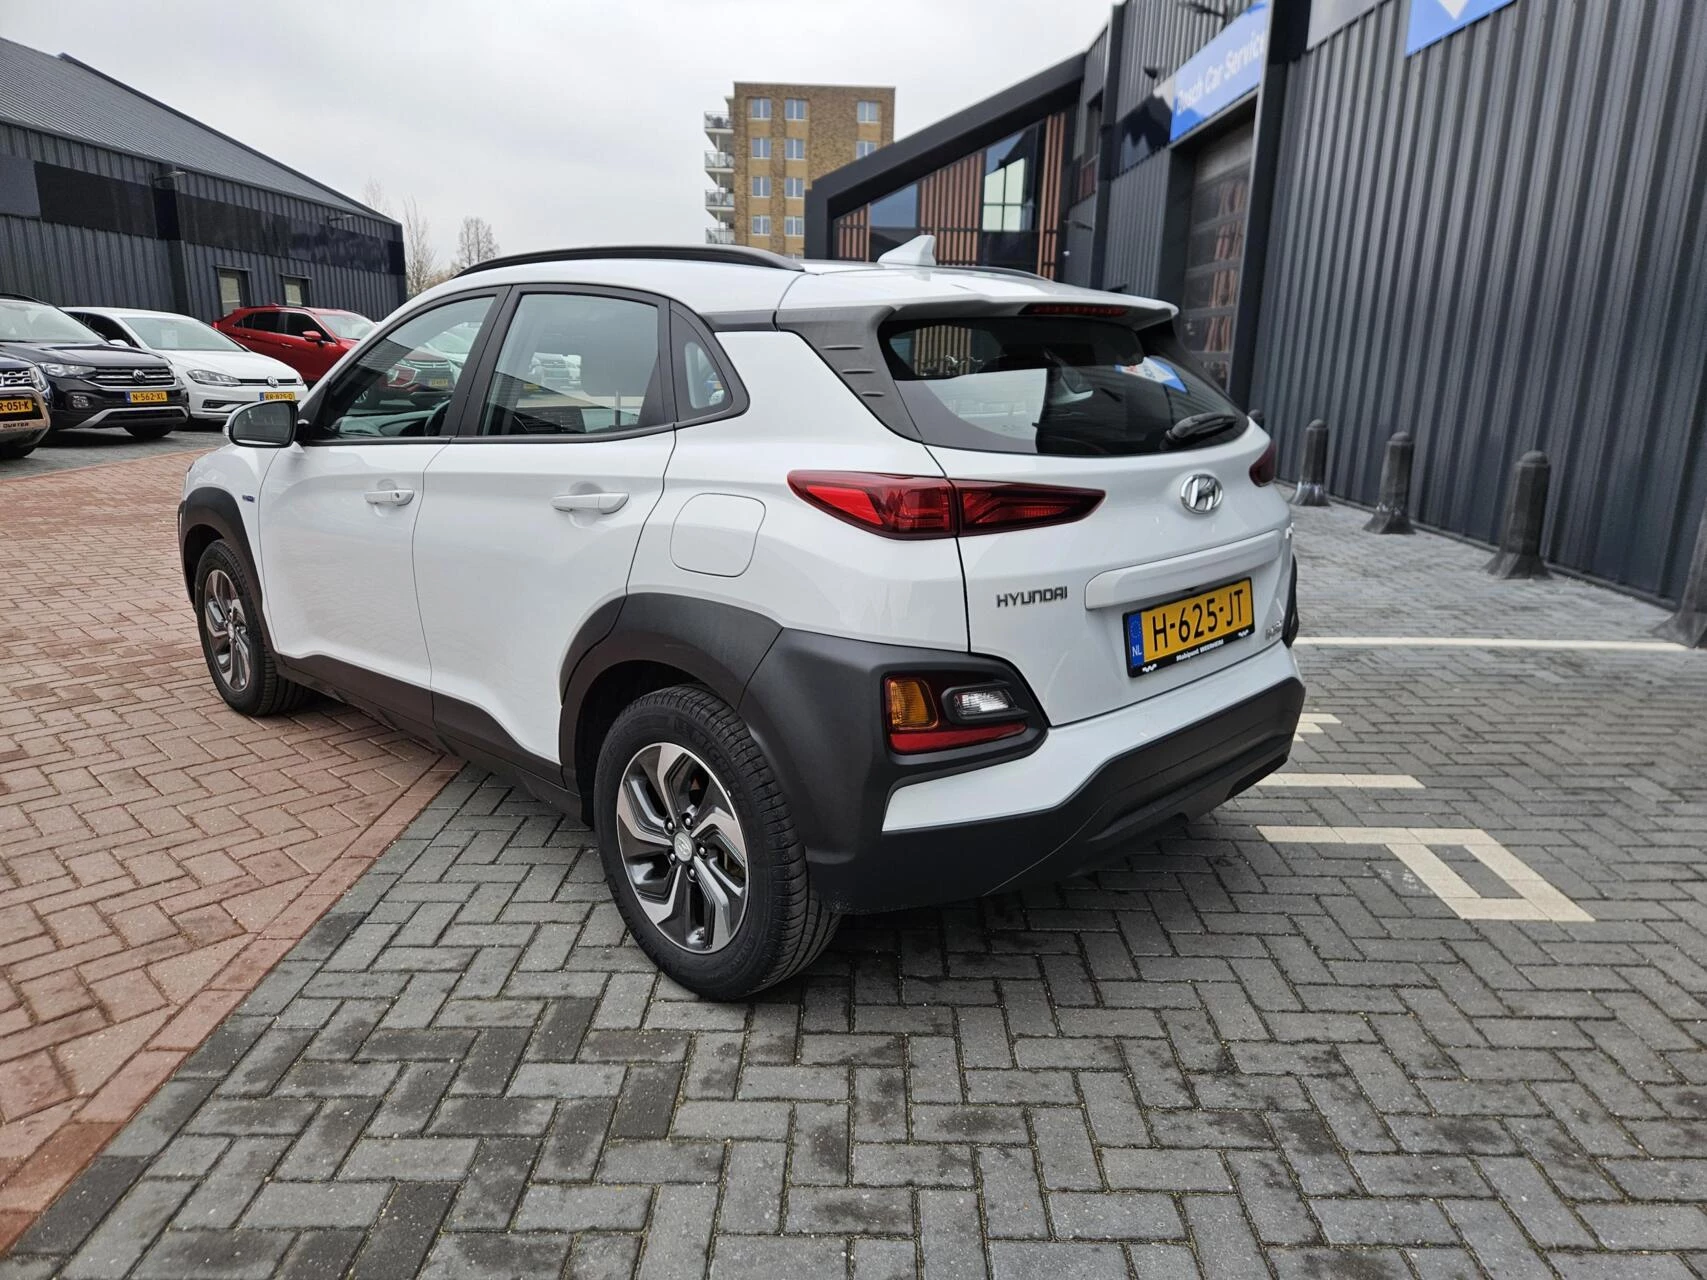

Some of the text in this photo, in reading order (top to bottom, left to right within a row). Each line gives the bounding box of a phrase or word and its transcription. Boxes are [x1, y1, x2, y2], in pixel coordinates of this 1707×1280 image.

[1205, 64, 1224, 94] Car
[132, 391, 165, 402] N-562-XL
[996, 586, 1068, 608] HYUNDAI
[1152, 589, 1244, 652] H-625-JT
[1131, 644, 1143, 657] NL
